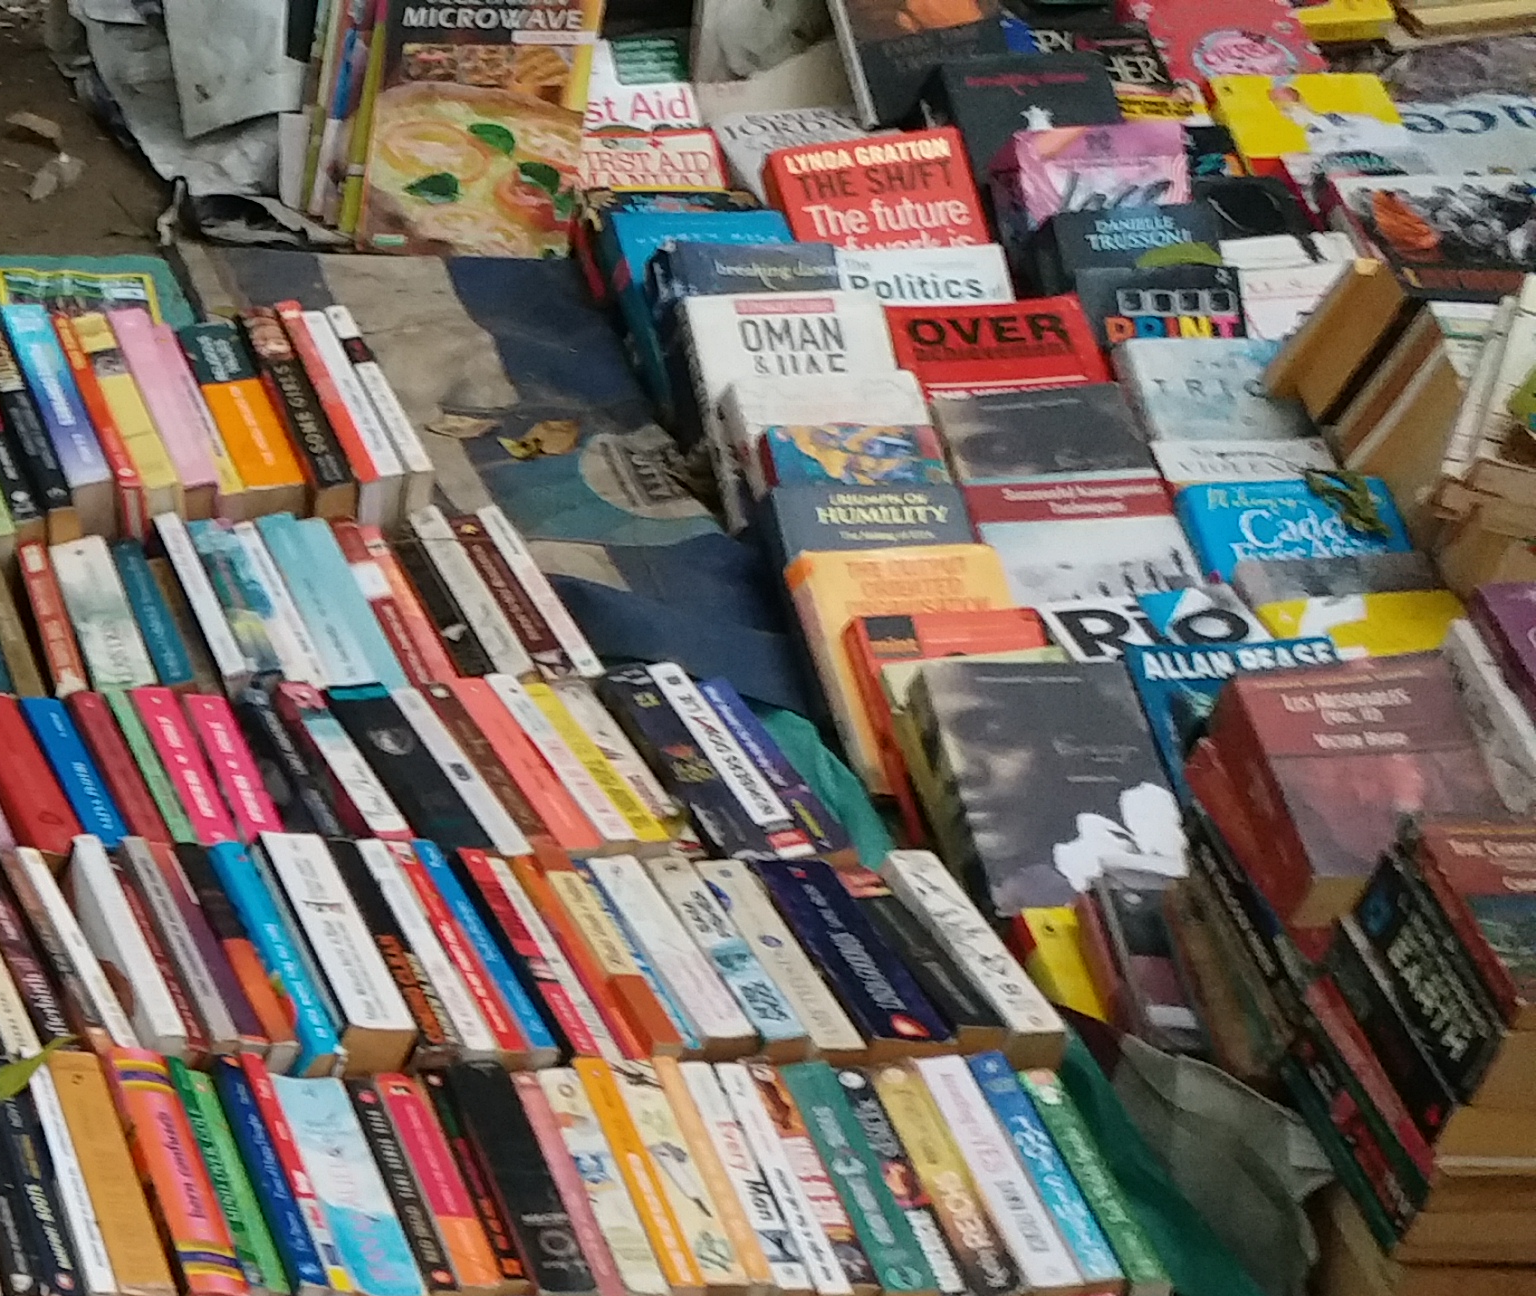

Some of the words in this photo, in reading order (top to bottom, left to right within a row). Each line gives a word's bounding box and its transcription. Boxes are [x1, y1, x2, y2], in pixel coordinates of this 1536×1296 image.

[402, 6, 584, 31] MICROWAVE
[629, 86, 693, 122] Aid
[668, 151, 711, 174] AID
[784, 147, 853, 173] LYNDA
[854, 137, 951, 164] GRATTON
[797, 168, 862, 200] THE
[864, 159, 955, 196] SHIFT
[803, 204, 871, 236] The
[874, 198, 971, 230] future
[849, 272, 985, 300] Politics
[738, 315, 846, 354] OMAN
[906, 312, 1073, 348] OVER
[814, 503, 950, 526] HUMILITY
[1143, 650, 1236, 681] ALLAN
[156, 1110, 194, 1179] confused
[184, 1178, 212, 1223] born
